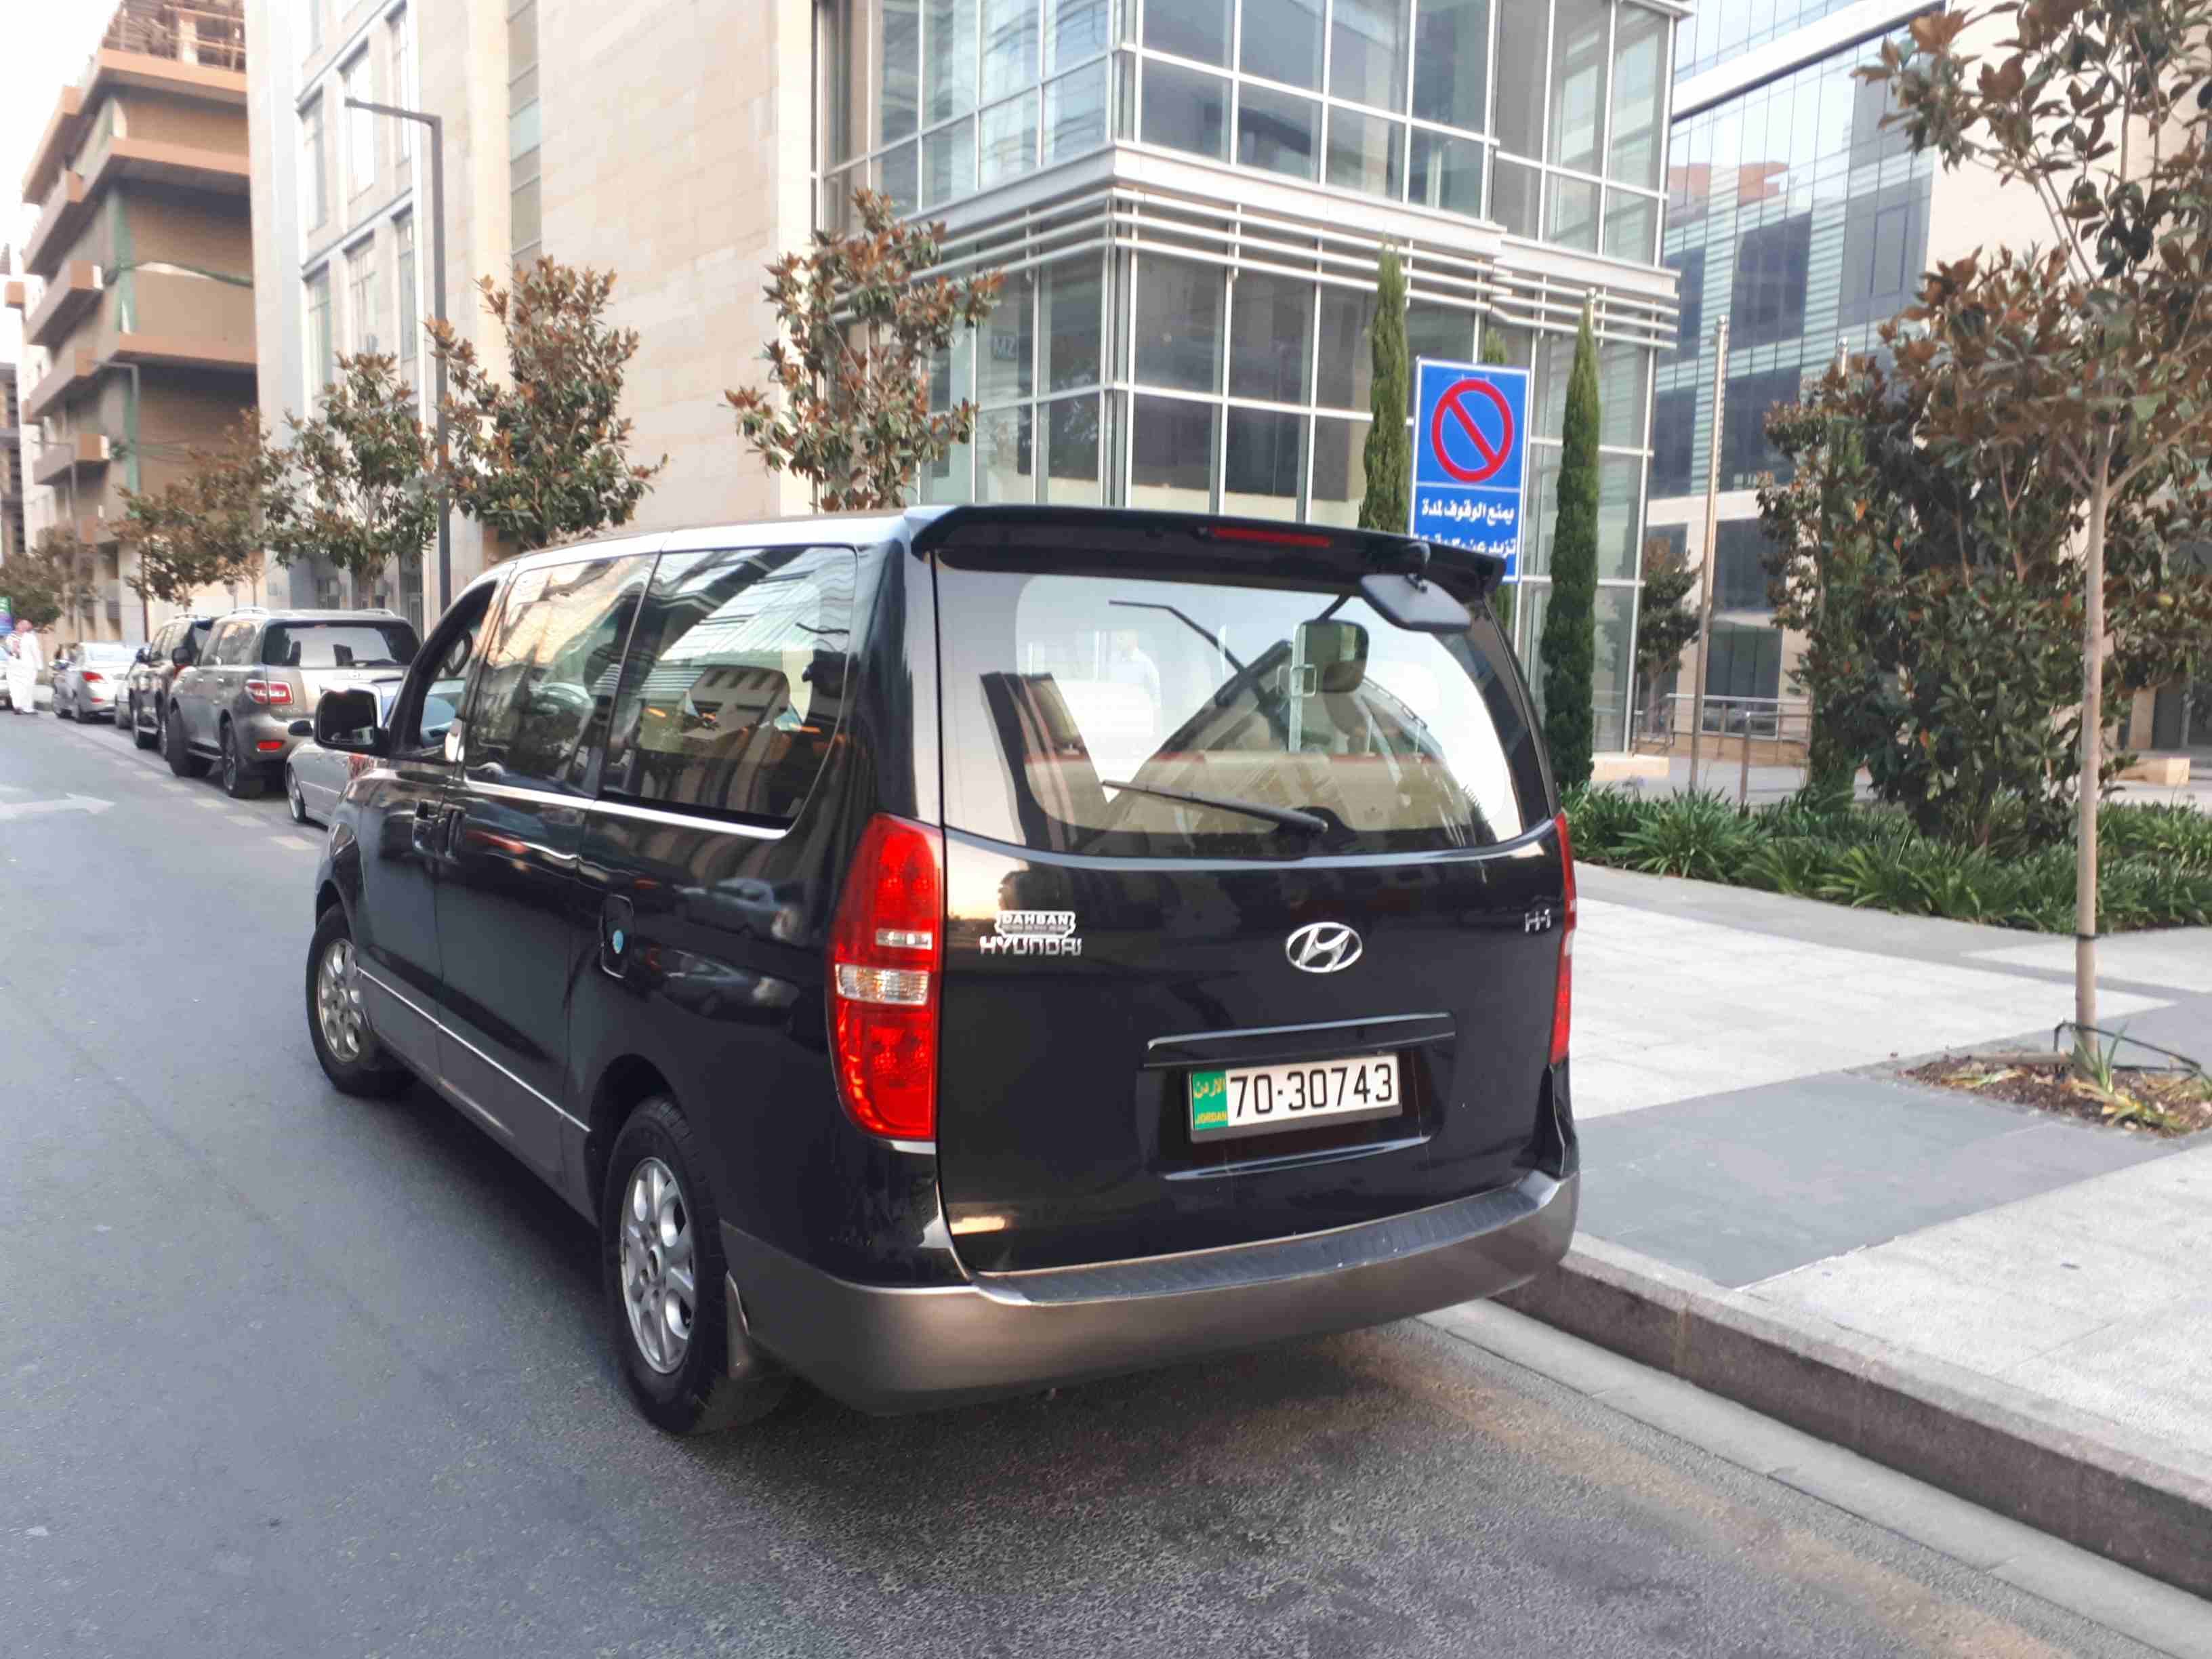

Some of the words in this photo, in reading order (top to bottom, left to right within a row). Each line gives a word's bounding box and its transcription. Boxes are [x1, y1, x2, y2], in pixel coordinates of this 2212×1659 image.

[1422, 497, 1443, 517] لمدة
[1444, 499, 1487, 523] الوقوف
[1487, 503, 1515, 526] يمنع
[979, 935, 1082, 956] HYUNDAI
